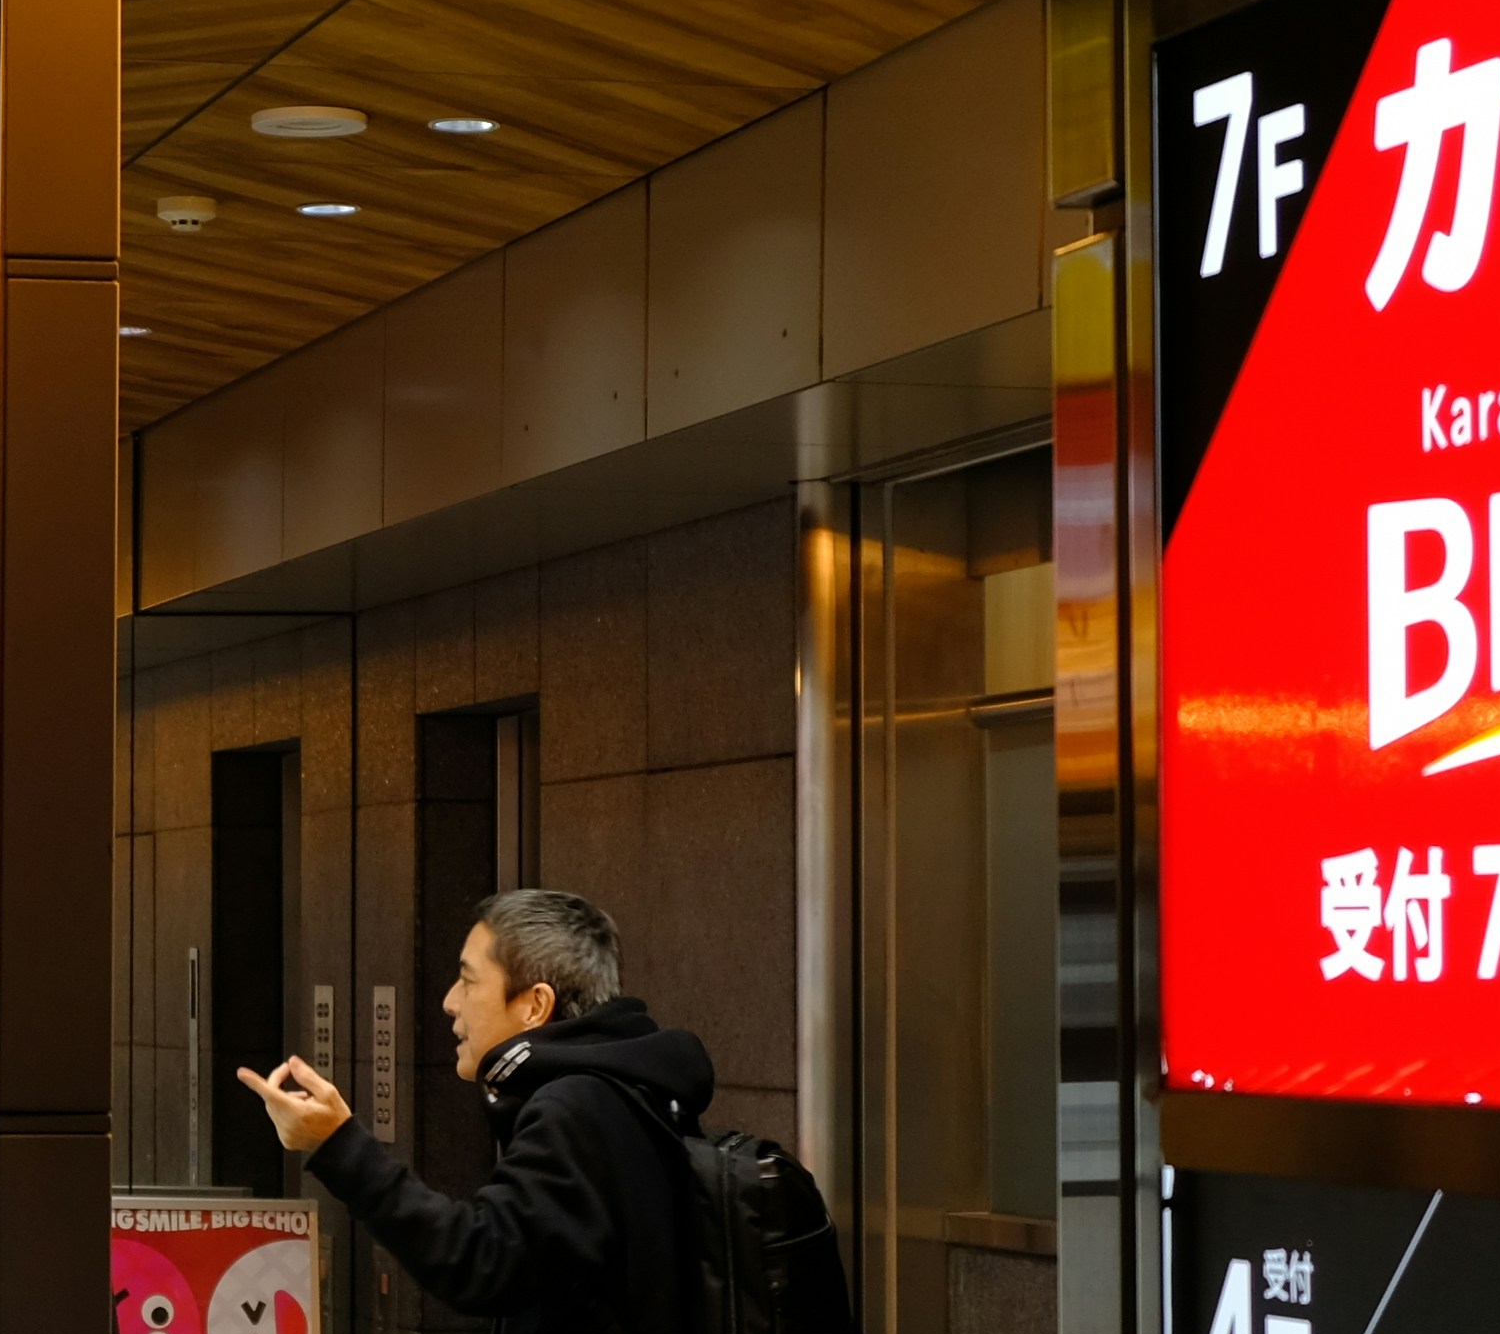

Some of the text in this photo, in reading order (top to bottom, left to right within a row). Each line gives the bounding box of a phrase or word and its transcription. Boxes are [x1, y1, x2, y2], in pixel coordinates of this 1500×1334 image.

[1192, 69, 1307, 279] 7F
[1320, 844, 1453, 983] 受付
[211, 1210, 250, 1229] BIG
[1262, 1246, 1314, 1307] 受付
